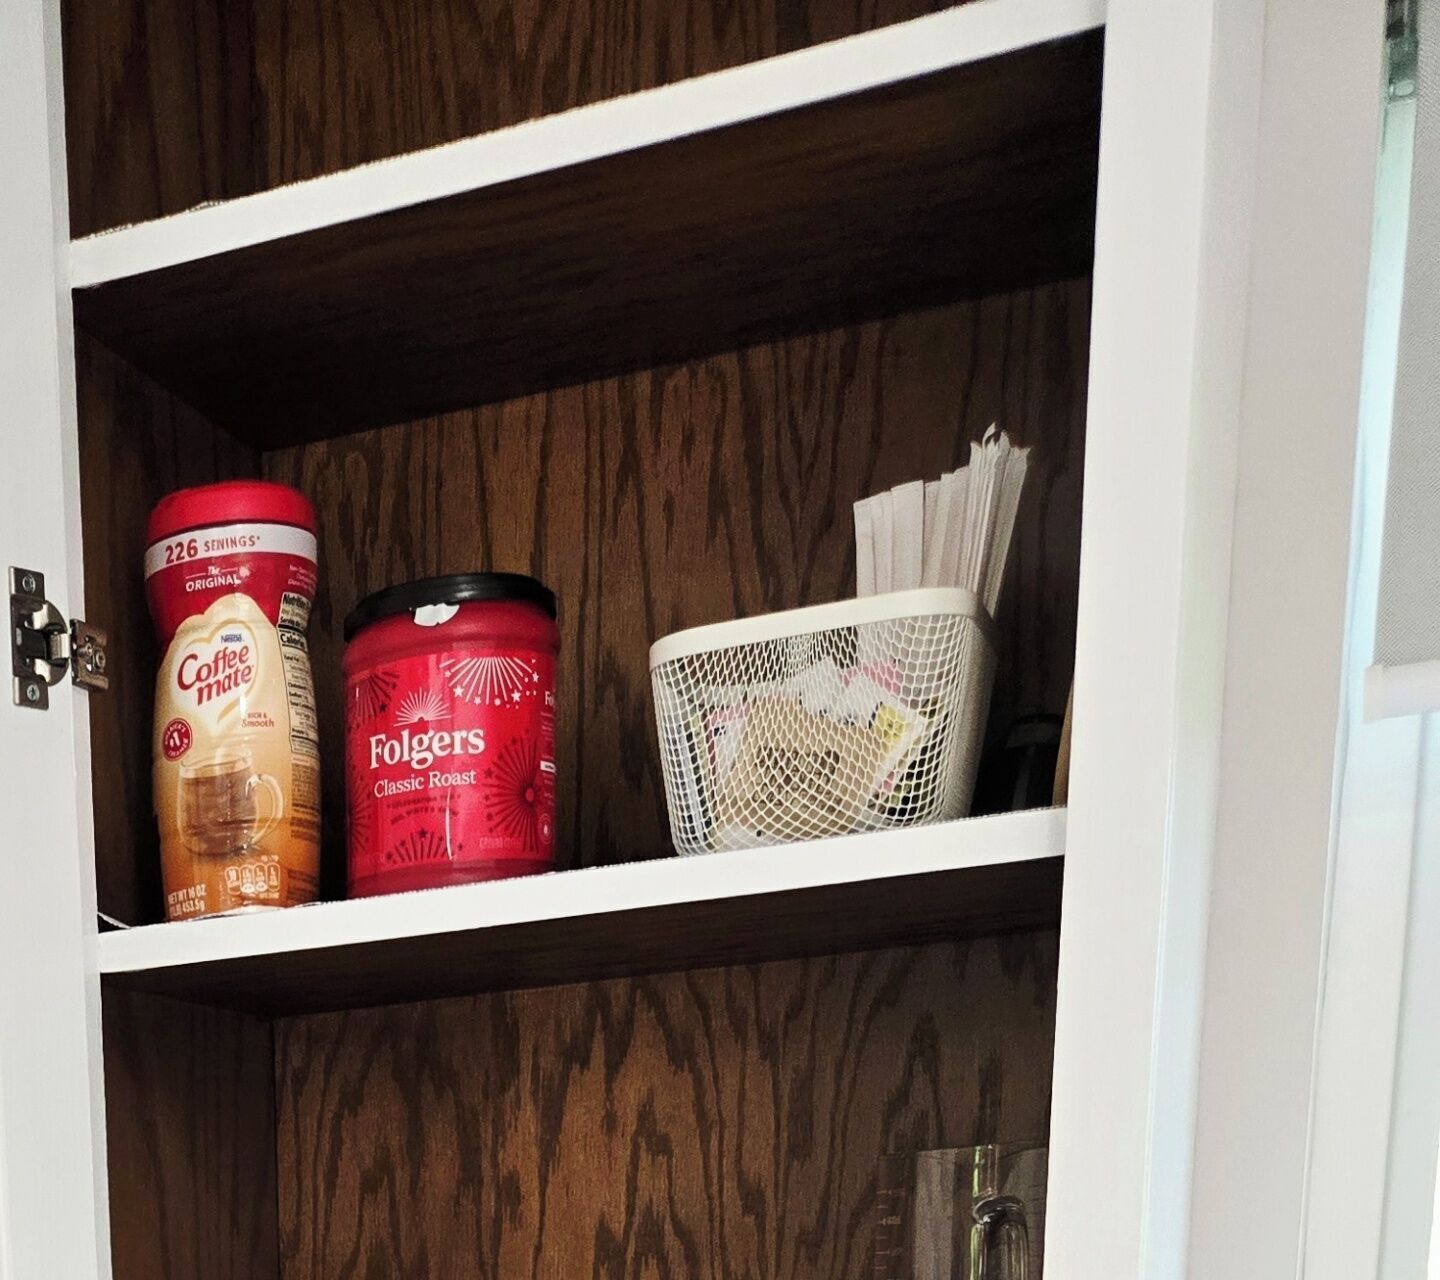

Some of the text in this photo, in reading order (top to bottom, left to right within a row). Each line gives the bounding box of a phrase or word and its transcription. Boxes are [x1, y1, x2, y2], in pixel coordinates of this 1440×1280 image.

[165, 538, 198, 565] 226
[185, 574, 242, 592] ORIGINAL
[177, 645, 250, 691] Coffee
[197, 665, 252, 706] mate
[369, 727, 485, 770] Folgers
[373, 769, 477, 798] Classic Roast
